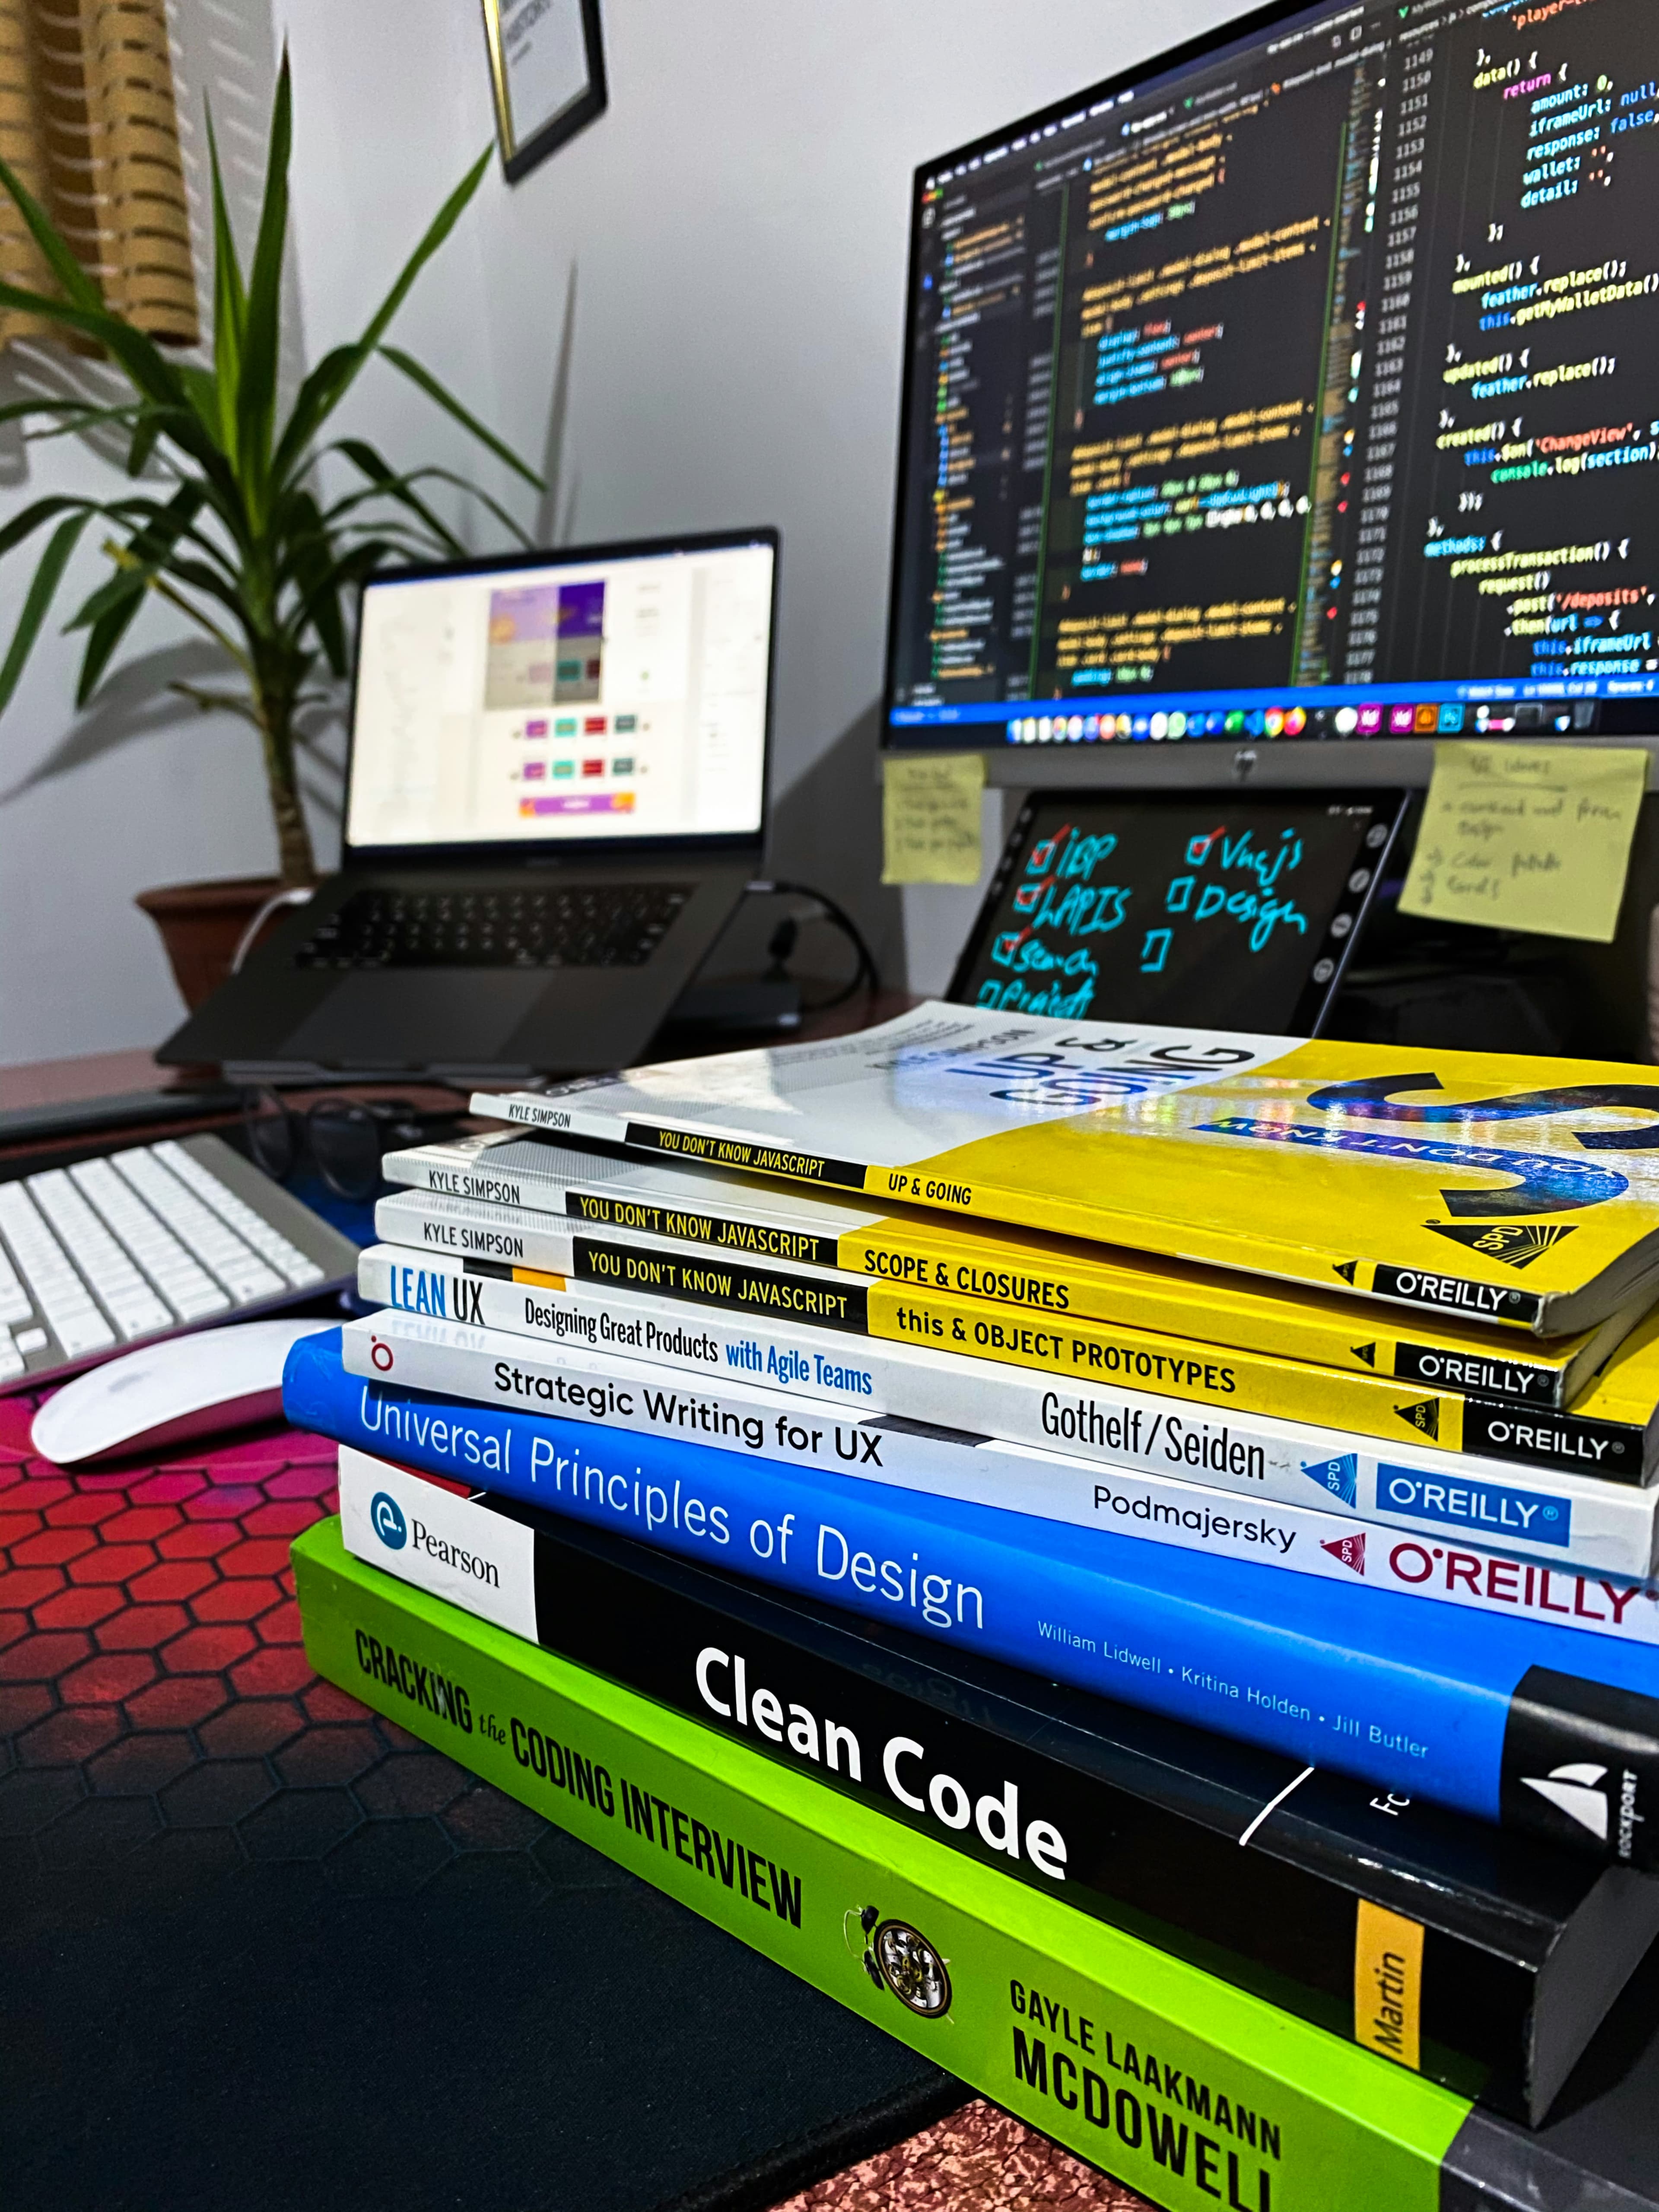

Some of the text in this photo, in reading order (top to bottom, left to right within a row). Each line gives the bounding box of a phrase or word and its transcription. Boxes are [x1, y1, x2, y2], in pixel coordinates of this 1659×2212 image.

[1473, 58, 1520, 89] data()
[1503, 73, 1551, 100] return
[1529, 99, 1611, 138] iframeUrl:
[1531, 83, 1589, 114] amount:
[1526, 126, 1600, 161] response:
[1522, 156, 1581, 186] wallet:
[1520, 179, 1579, 208] detail:
[1452, 260, 1522, 294] mounted()
[1481, 259, 1627, 309] feather.replace();
[1443, 352, 1512, 385] updated()
[1471, 357, 1616, 400] feather.replace();
[1436, 420, 1506, 449] created()
[1478, 570, 1551, 596] request()
[1193, 884, 1307, 952] Design
[945, 1052, 1084, 1080] UP
[509, 1104, 571, 1128] KYLE SIMPSON
[659, 1130, 825, 1177] YOU DON'T KNOW JAVASCRIPT
[429, 1170, 520, 1205] KYLE SIMPSON
[888, 1173, 972, 1205] UP & GOING
[424, 1222, 524, 1258] KYLE SIMPSON
[580, 1196, 820, 1260] YOU DON'T KNOW JAVASCRIPT
[1472, 1225, 1524, 1251] SPD
[391, 1264, 486, 1326] LEAN UX
[588, 1251, 848, 1319] YOU DON'T KNOW JAVASCRIPT
[864, 1249, 1069, 1309] SCOPE & CLOSURES
[524, 1297, 873, 1395] Designing Great Products with Agile Teams
[897, 1307, 1236, 1393] this & OBJECT PROTOTYPES
[495, 1361, 884, 1467] Strategic Writing for UX
[1415, 1405, 1426, 1428] SPD
[1042, 1392, 1265, 1481] Gothelf/Seiden
[1328, 1461, 1340, 1491] SPD
[361, 1385, 985, 1629] Universal Principles of Design
[1093, 1485, 1297, 1554] Podmajersky
[411, 1519, 500, 1589] Pearson
[1341, 1539, 1353, 1563] SPD
[1038, 1619, 1429, 1759] William Lidwell Kritina Holden Jill Butler
[355, 1629, 802, 1929] CRACKING the CODING INTERVIEW
[696, 1646, 1067, 1881] Clean Code
[1374, 1952, 1405, 2054] Martin
[1010, 1979, 1281, 2161] GAYLE LAAKMANN
